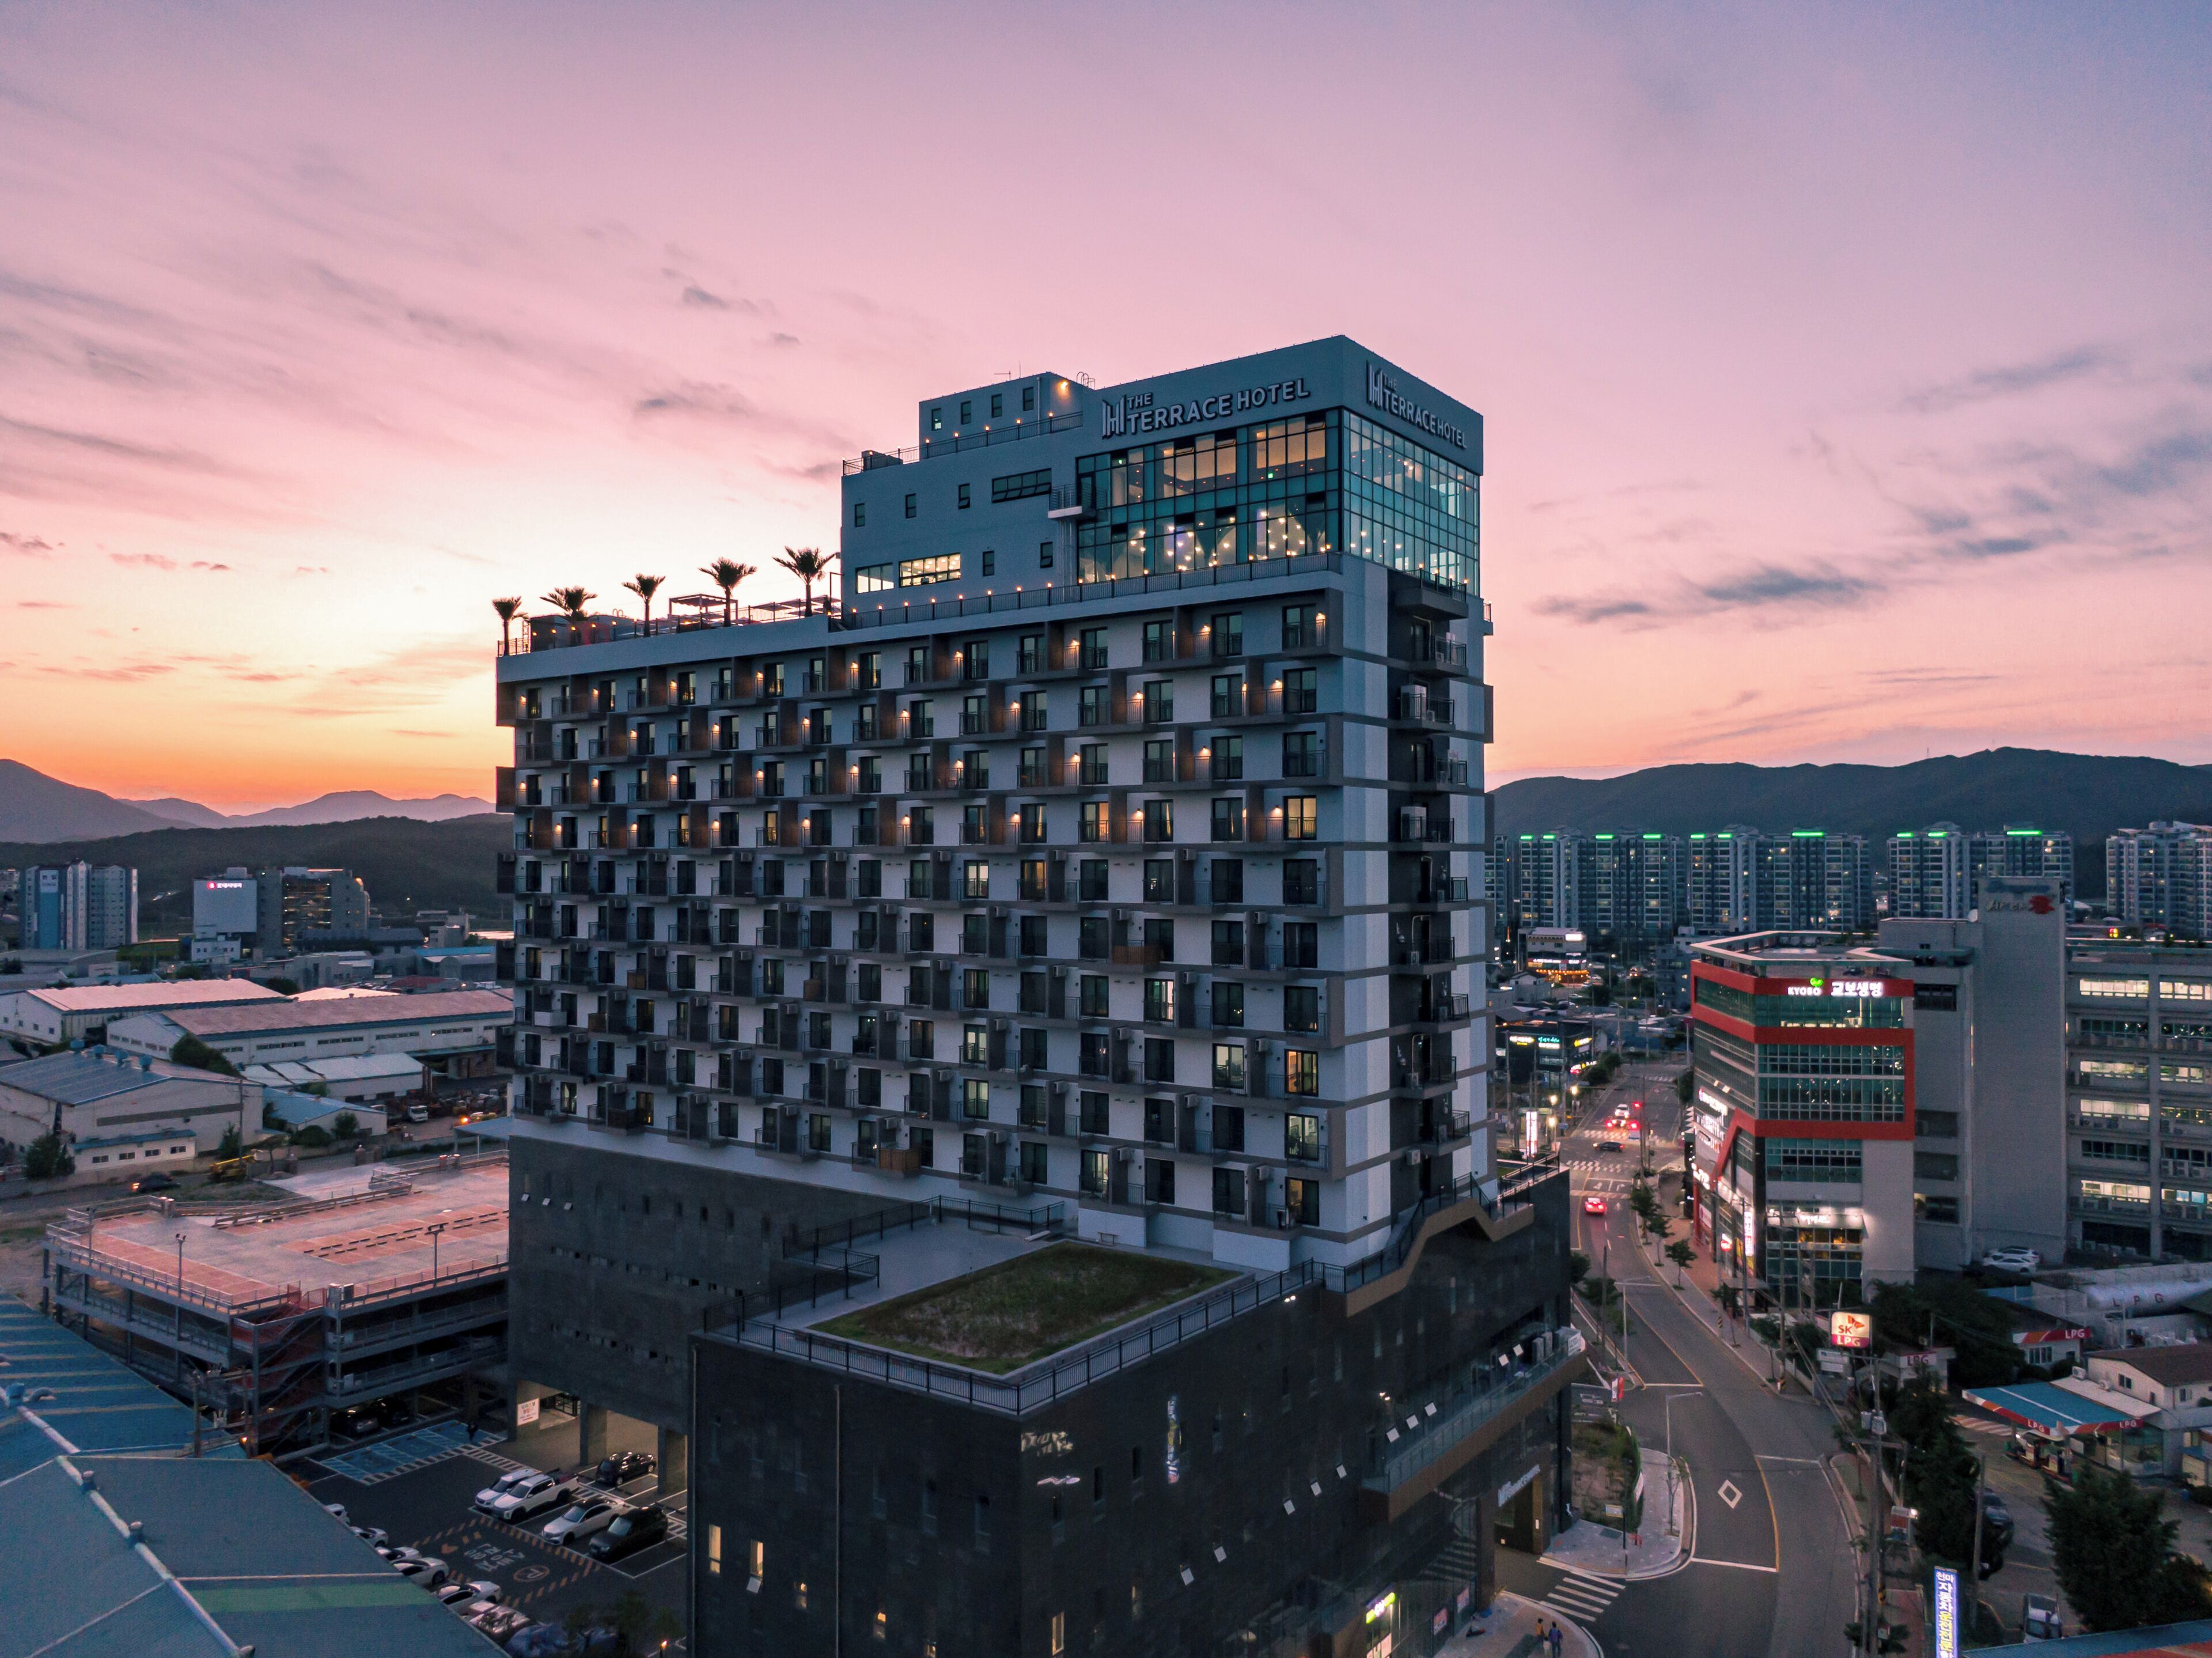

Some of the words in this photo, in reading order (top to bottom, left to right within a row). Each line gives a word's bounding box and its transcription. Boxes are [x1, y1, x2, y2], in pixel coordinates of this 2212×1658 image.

[1384, 374, 1397, 389] THE
[1127, 393, 1152, 410] THE
[1127, 394, 1232, 433] TERRACE
[1237, 378, 1310, 409] HOTEL
[1384, 388, 1436, 434] TERRACE
[1437, 418, 1467, 449] HOTEL
[1787, 986, 1821, 995] KYOBO
[1831, 981, 1883, 997] 교보생명
[1838, 1324, 1853, 1334] SK
[2067, 1329, 2085, 1339] LPG
[1836, 1335, 1860, 1346] LPG
[2028, 1419, 2044, 1432] LPG
[2120, 1419, 2137, 1428] LPG
